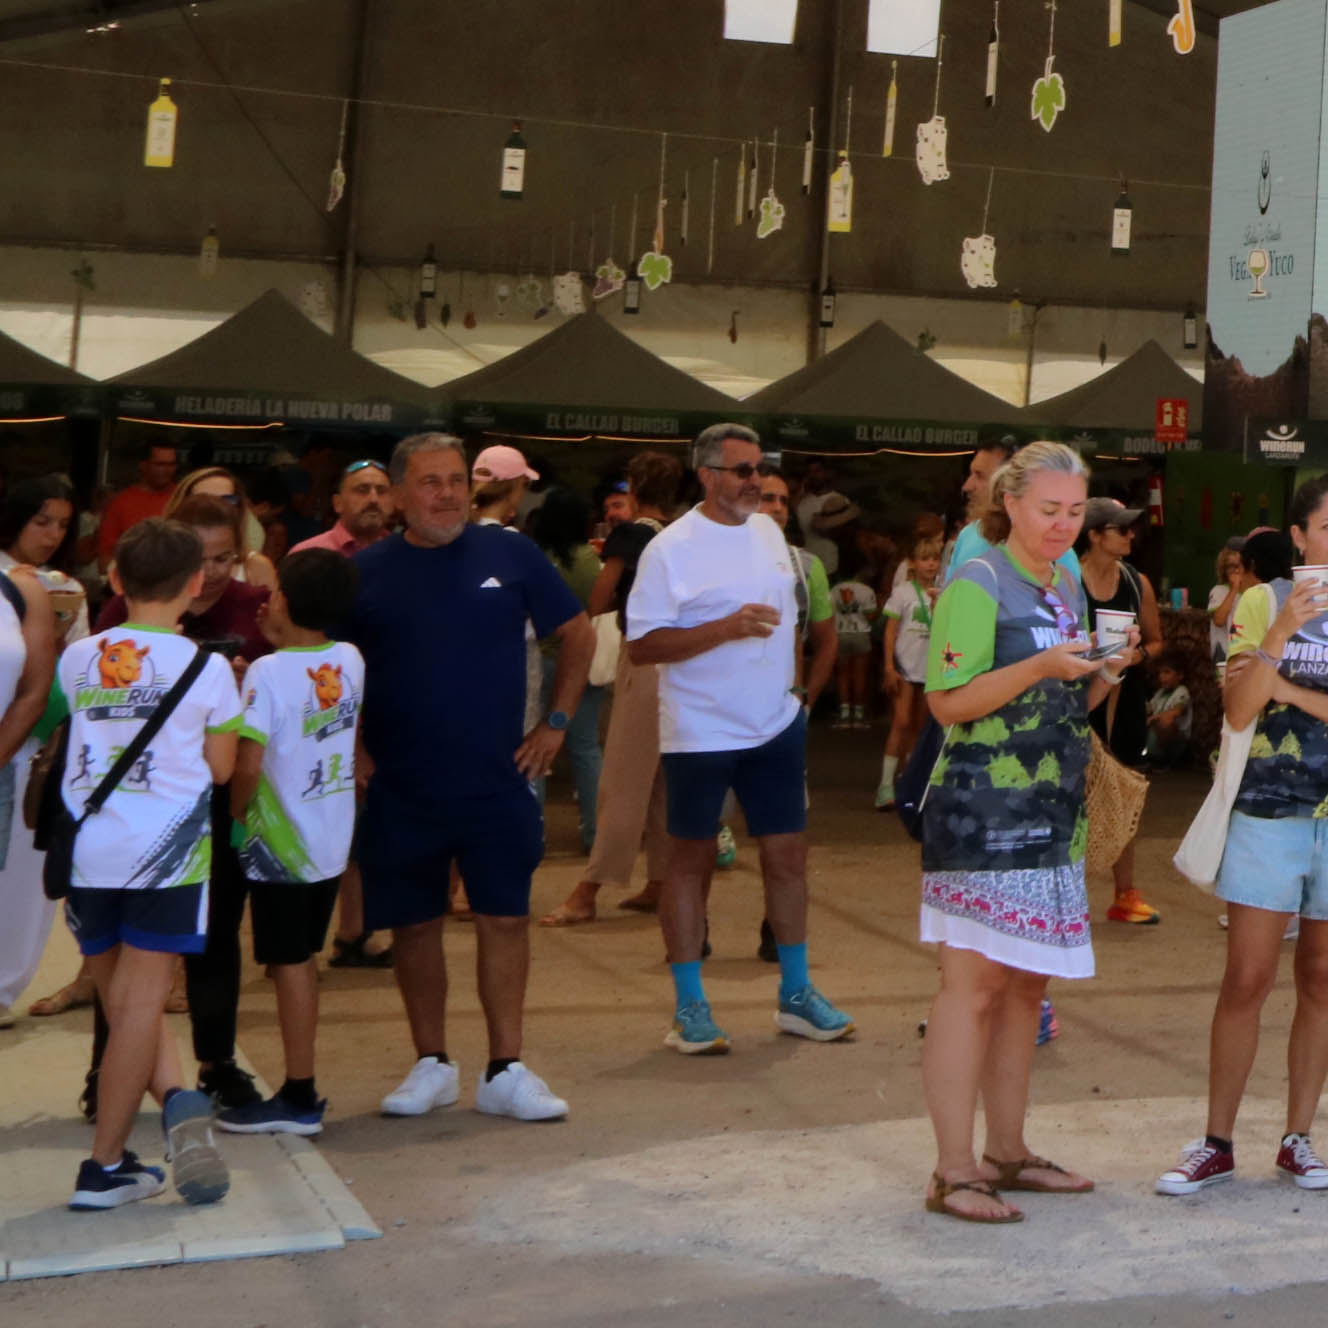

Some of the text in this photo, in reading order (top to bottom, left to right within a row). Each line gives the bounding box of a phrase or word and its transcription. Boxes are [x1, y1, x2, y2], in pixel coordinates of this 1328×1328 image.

[1229, 250, 1294, 280] VEG YUCO
[265, 400, 284, 417] LA
[342, 402, 392, 423] POLAR
[546, 414, 561, 429] EL
[856, 425, 868, 441] EL
[304, 700, 357, 736] WINERU
